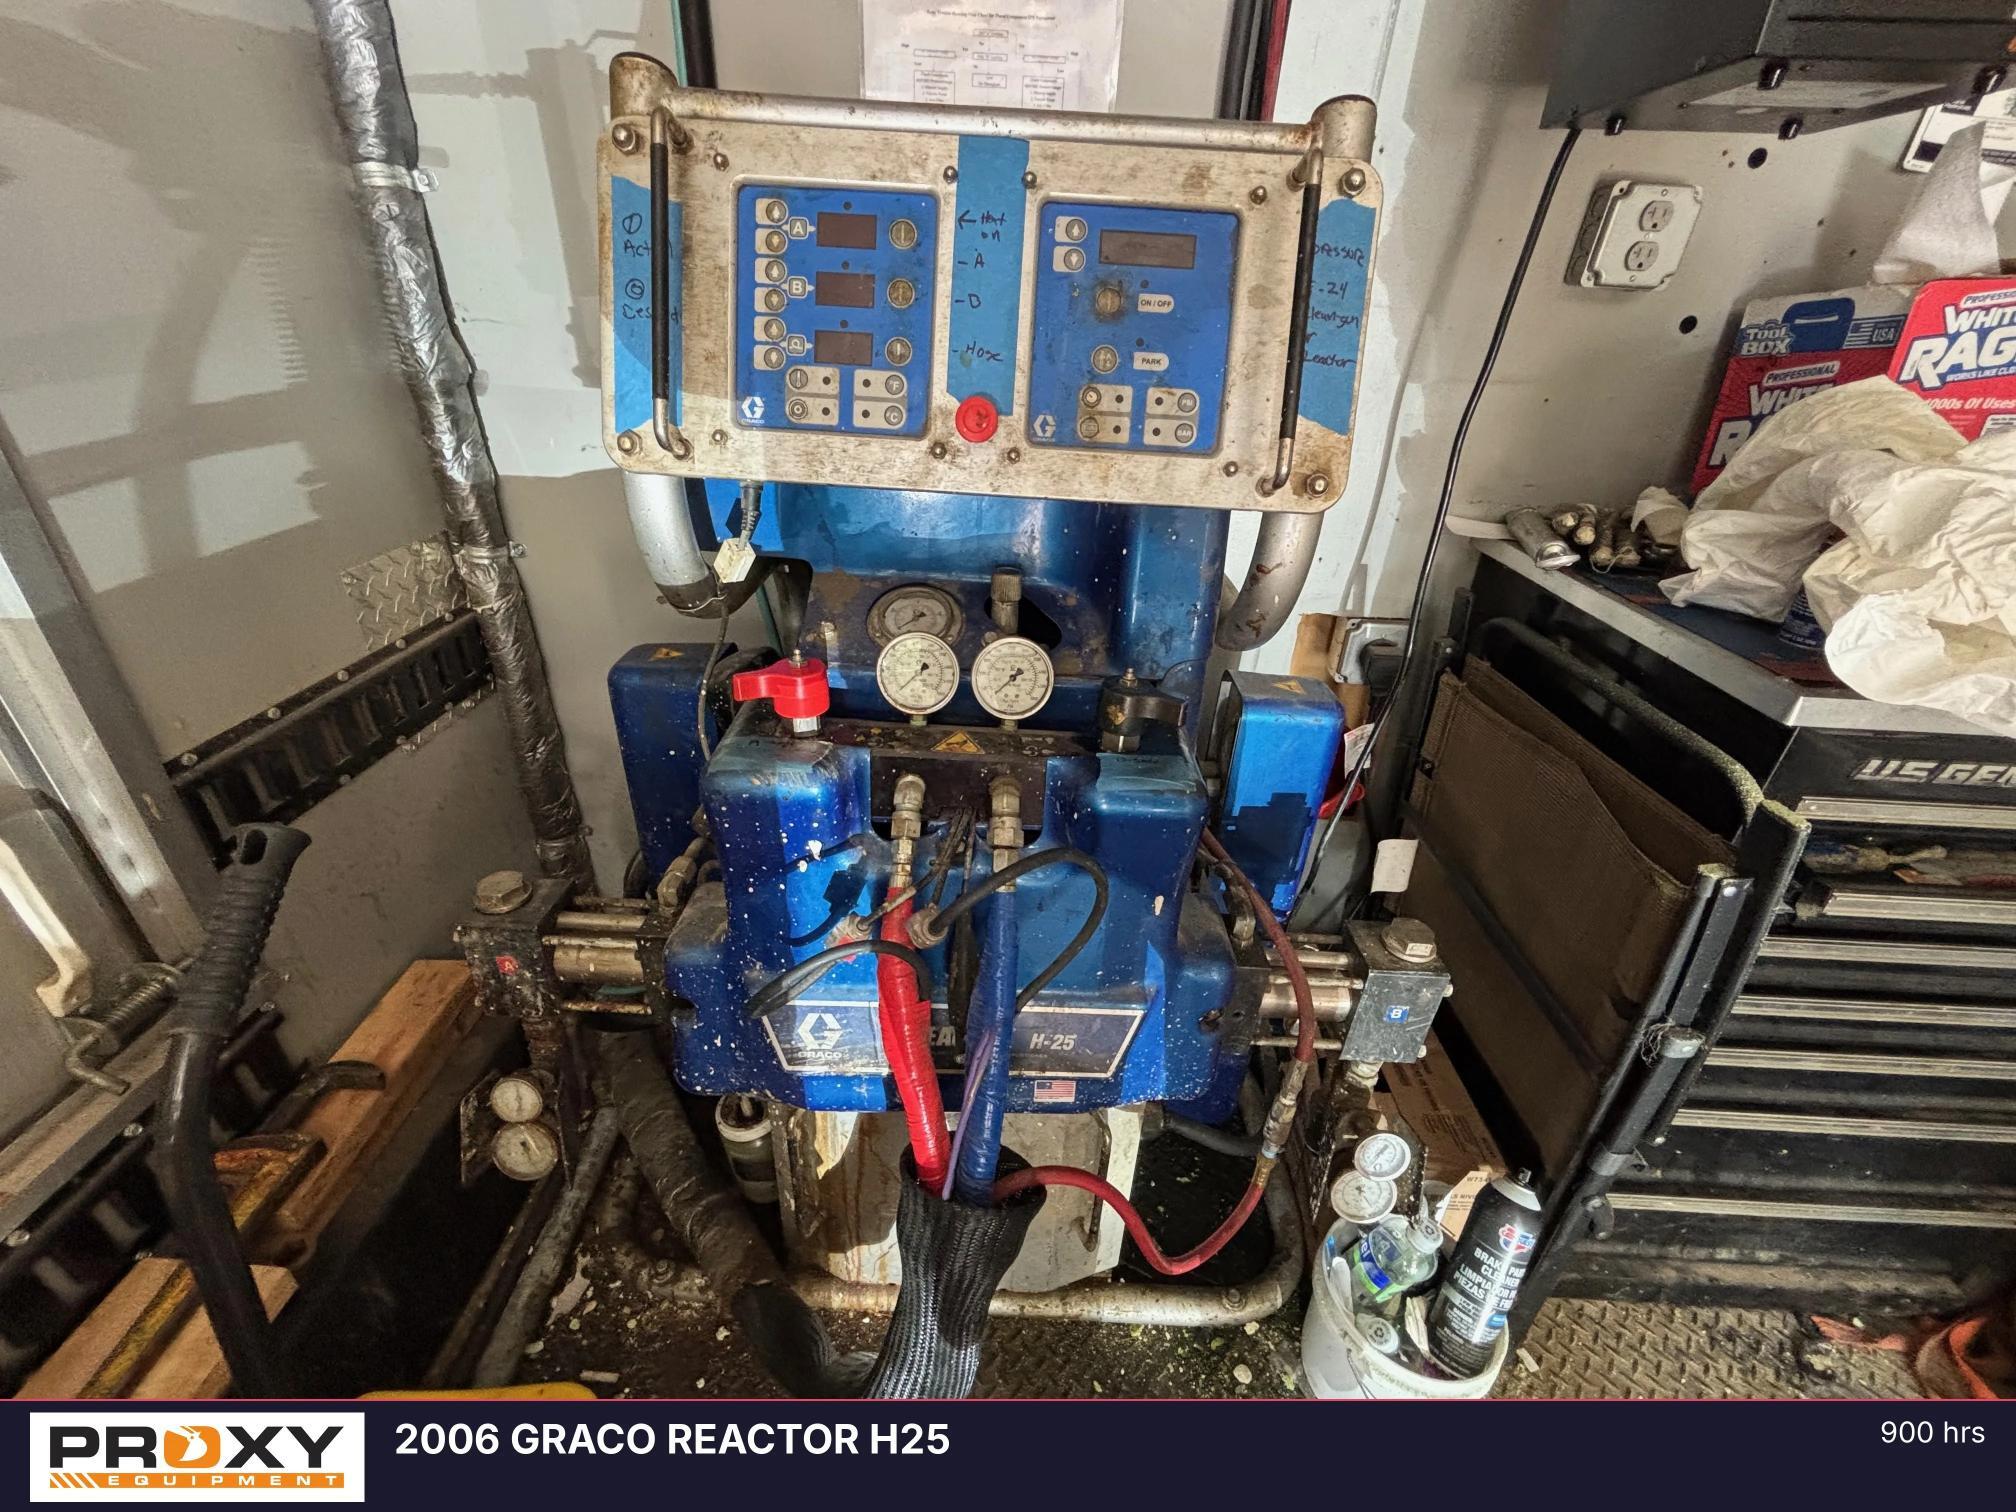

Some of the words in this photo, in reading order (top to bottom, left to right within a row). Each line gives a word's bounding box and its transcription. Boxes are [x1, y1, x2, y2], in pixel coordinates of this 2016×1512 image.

[793, 221, 804, 235] A
[792, 280, 803, 294] B
[1141, 299, 1152, 307] ON
[1157, 300, 1171, 308] OFF
[1746, 326, 1790, 340] TOOL
[1871, 326, 1896, 342] USA
[1740, 338, 1793, 356] BOX
[1141, 357, 1162, 366] PARK
[1900, 326, 2016, 389] RAG
[1765, 363, 1837, 384] PROFESSIONAL
[1177, 429, 1191, 437] BAR
[1853, 758, 1939, 784] US
[1391, 1008, 1402, 1019] B
[1029, 1032, 1077, 1051] H-25
[798, 1050, 843, 1060] GRACO
[1453, 1270, 1487, 1301] PIEZAS
